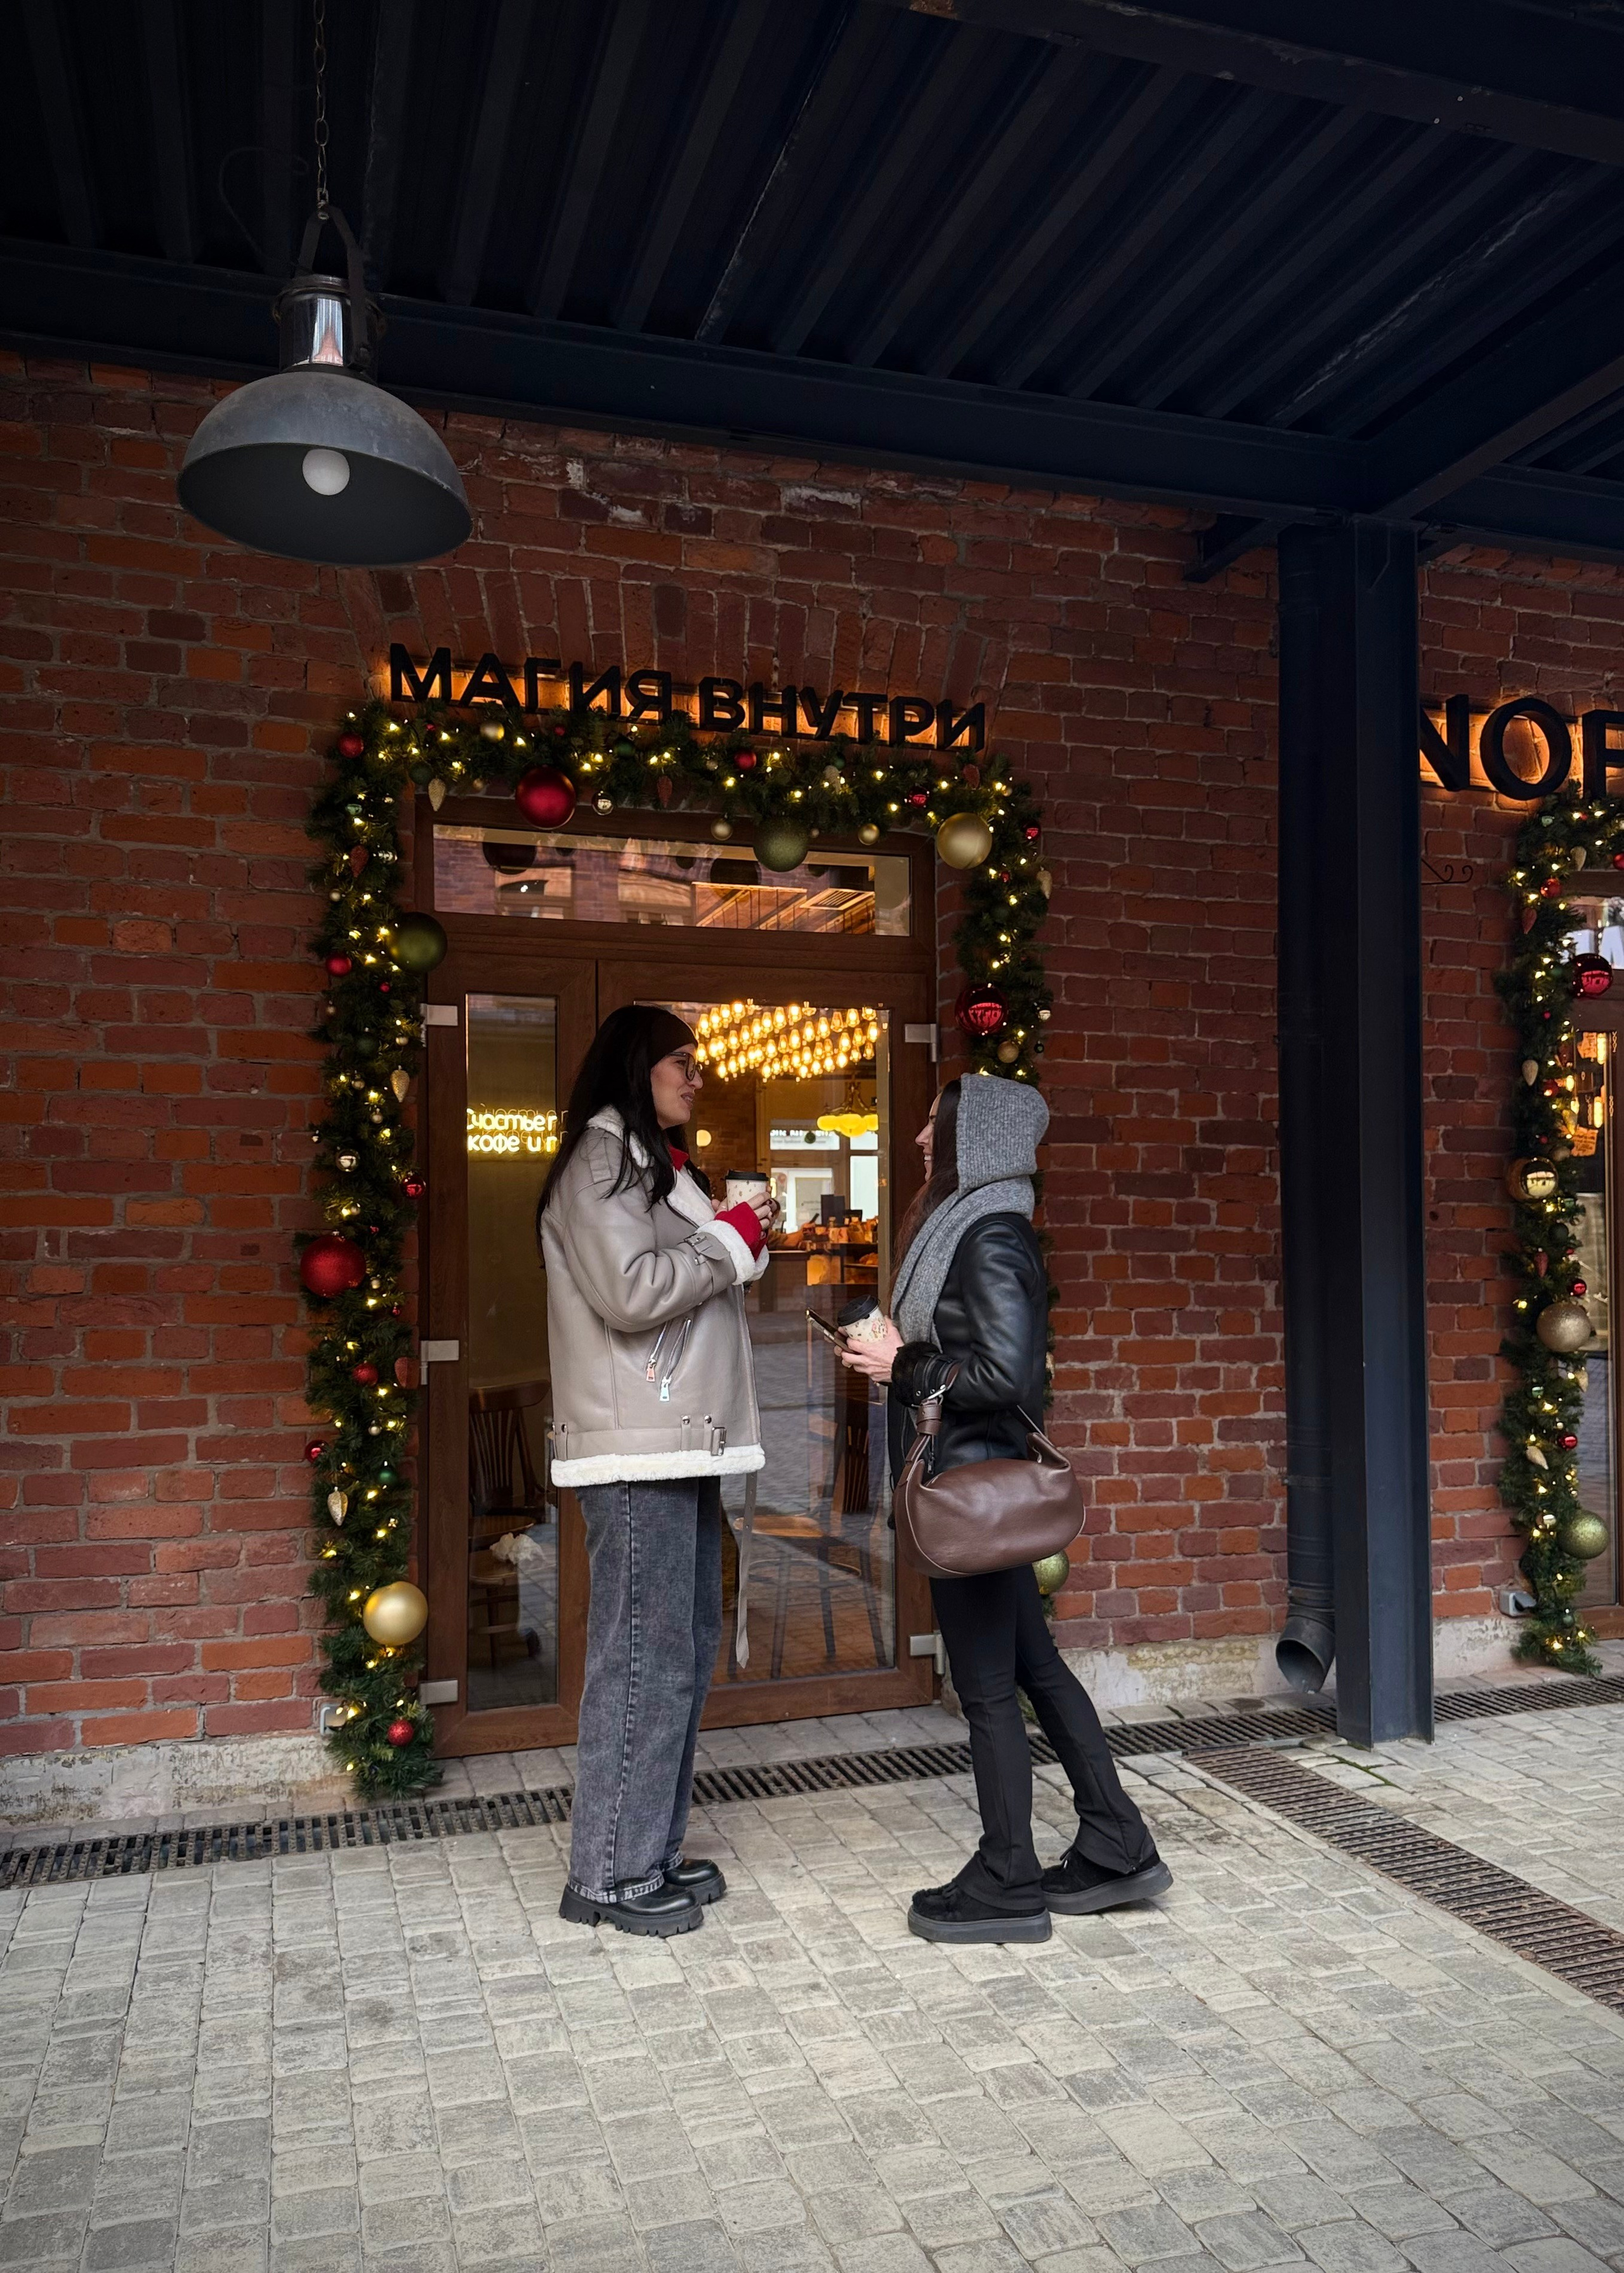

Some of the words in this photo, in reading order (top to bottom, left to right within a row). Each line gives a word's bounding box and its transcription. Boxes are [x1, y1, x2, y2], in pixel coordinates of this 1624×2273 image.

[390, 643, 672, 724] МАГИЯ
[699, 676, 985, 752] ВНУТРИ
[468, 1133, 520, 1154] кофе
